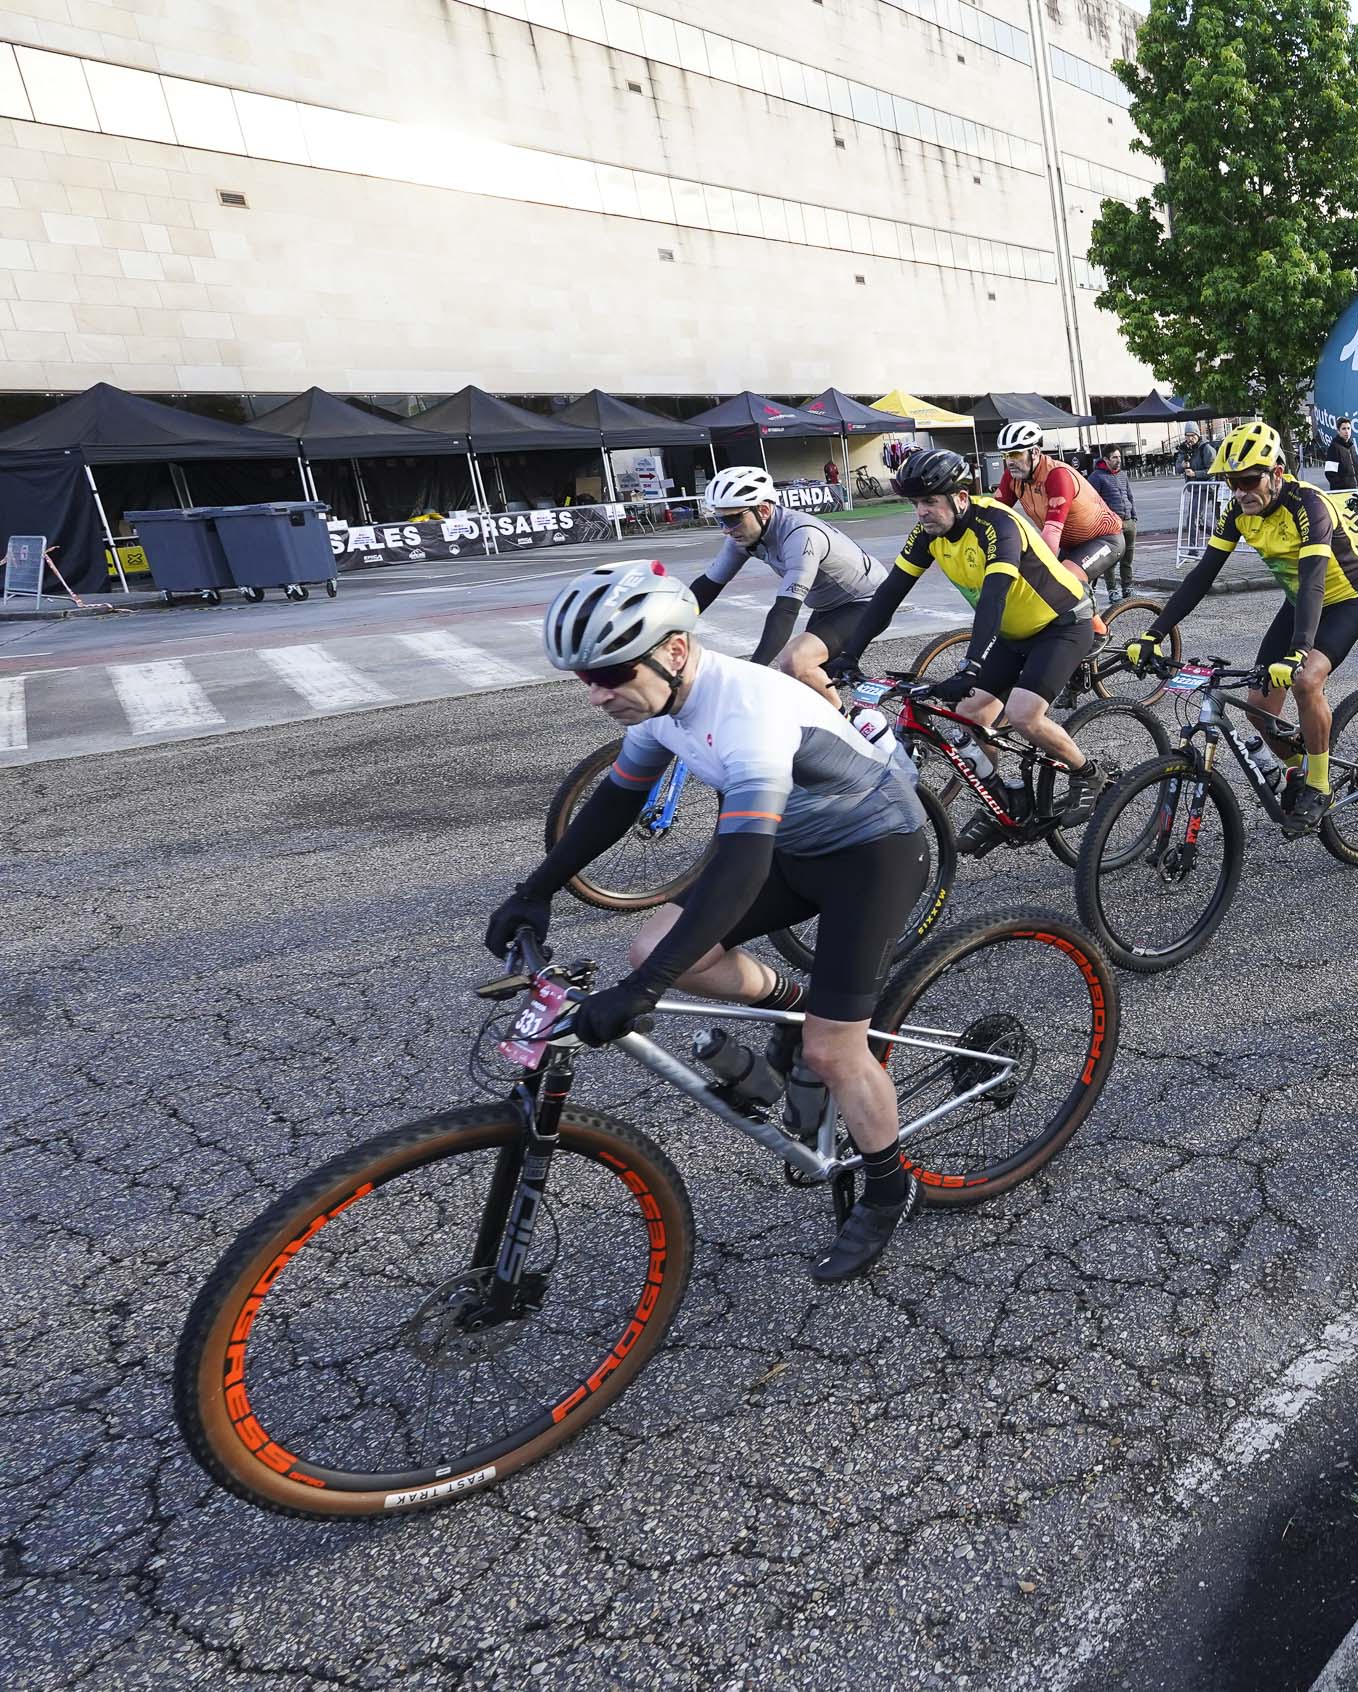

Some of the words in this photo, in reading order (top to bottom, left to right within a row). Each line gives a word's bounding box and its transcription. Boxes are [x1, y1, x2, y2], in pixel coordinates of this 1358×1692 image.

[776, 486, 834, 506] TIENDA
[604, 569, 646, 607] MET
[1229, 729, 1266, 785] MMR
[948, 747, 1003, 816] SPECIALIZED
[918, 888, 947, 935] MAXXIS
[515, 1008, 543, 1039] 331
[396, 1489, 439, 1505] TRAK
[447, 1471, 485, 1493] FAST
